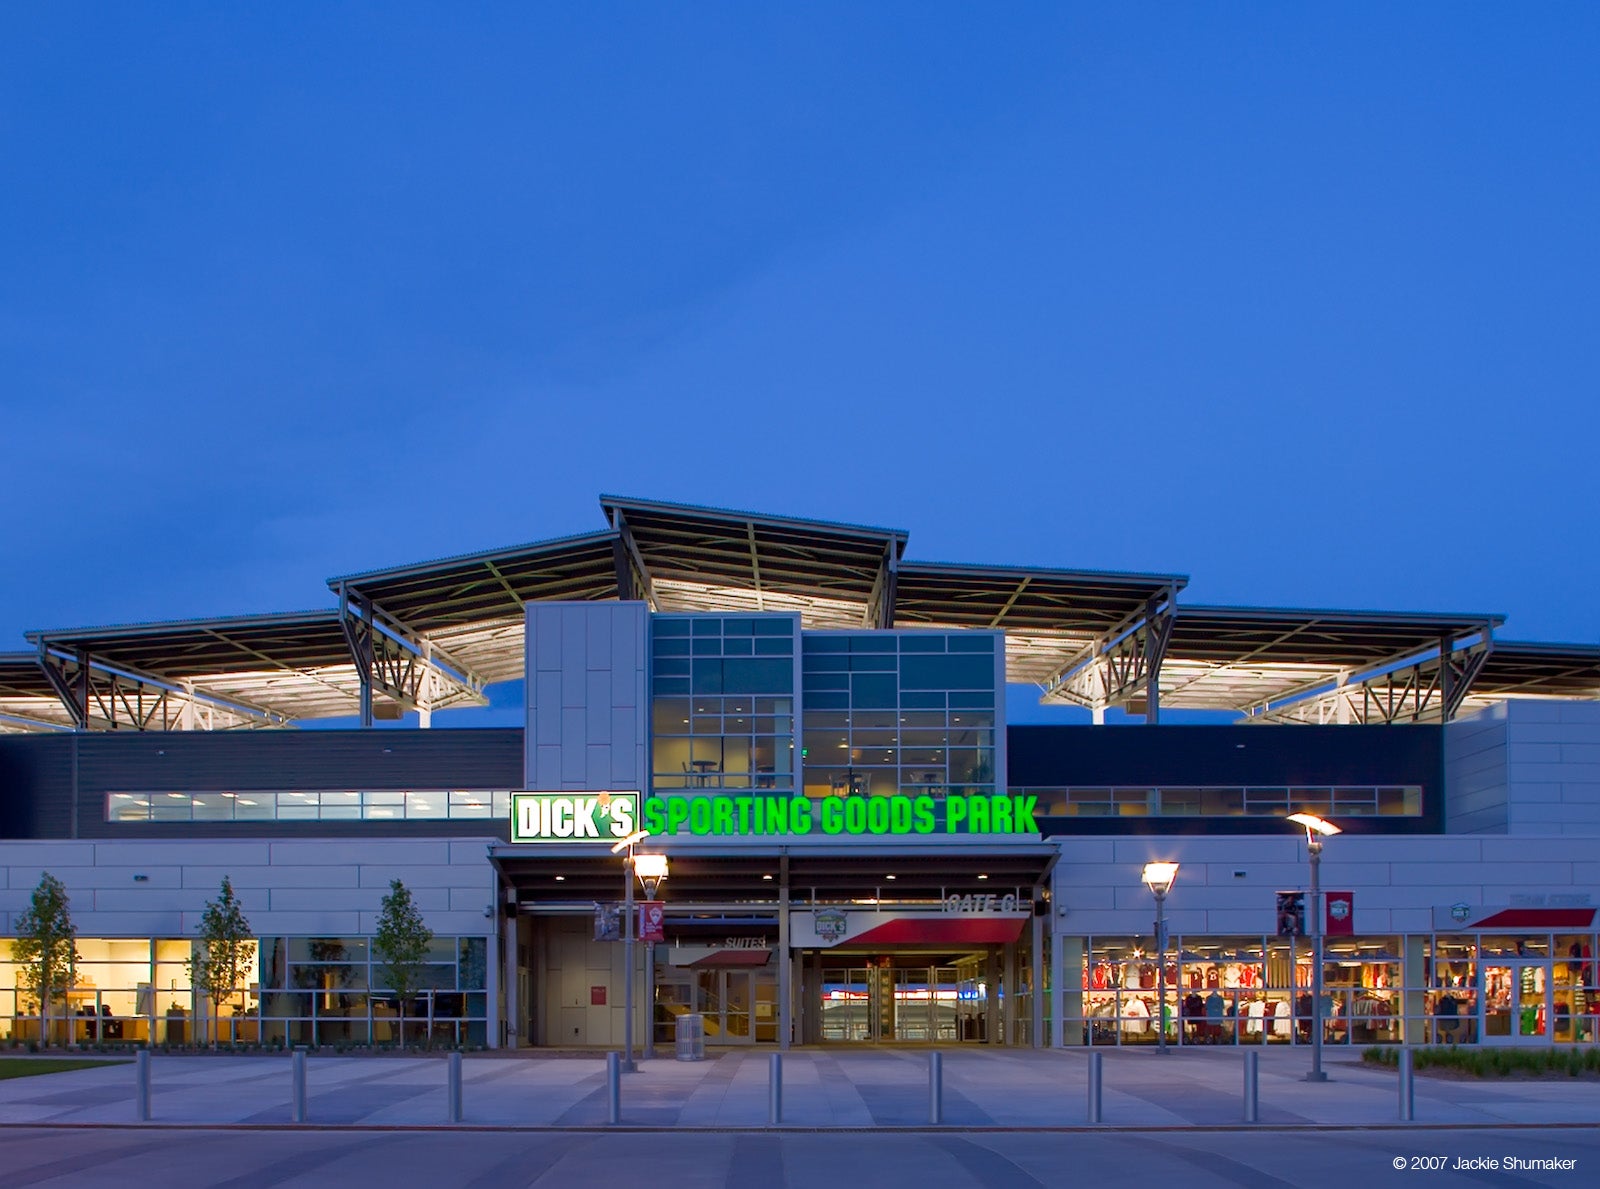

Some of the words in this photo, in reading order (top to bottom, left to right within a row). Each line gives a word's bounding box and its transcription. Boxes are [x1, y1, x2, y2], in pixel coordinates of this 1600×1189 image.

[517, 797, 633, 837] DICK'S
[644, 796, 812, 836] SPORTING
[821, 795, 935, 835] GOODS
[946, 795, 1040, 834] PARK
[946, 893, 998, 912] GATE
[724, 937, 766, 949] SUITES
